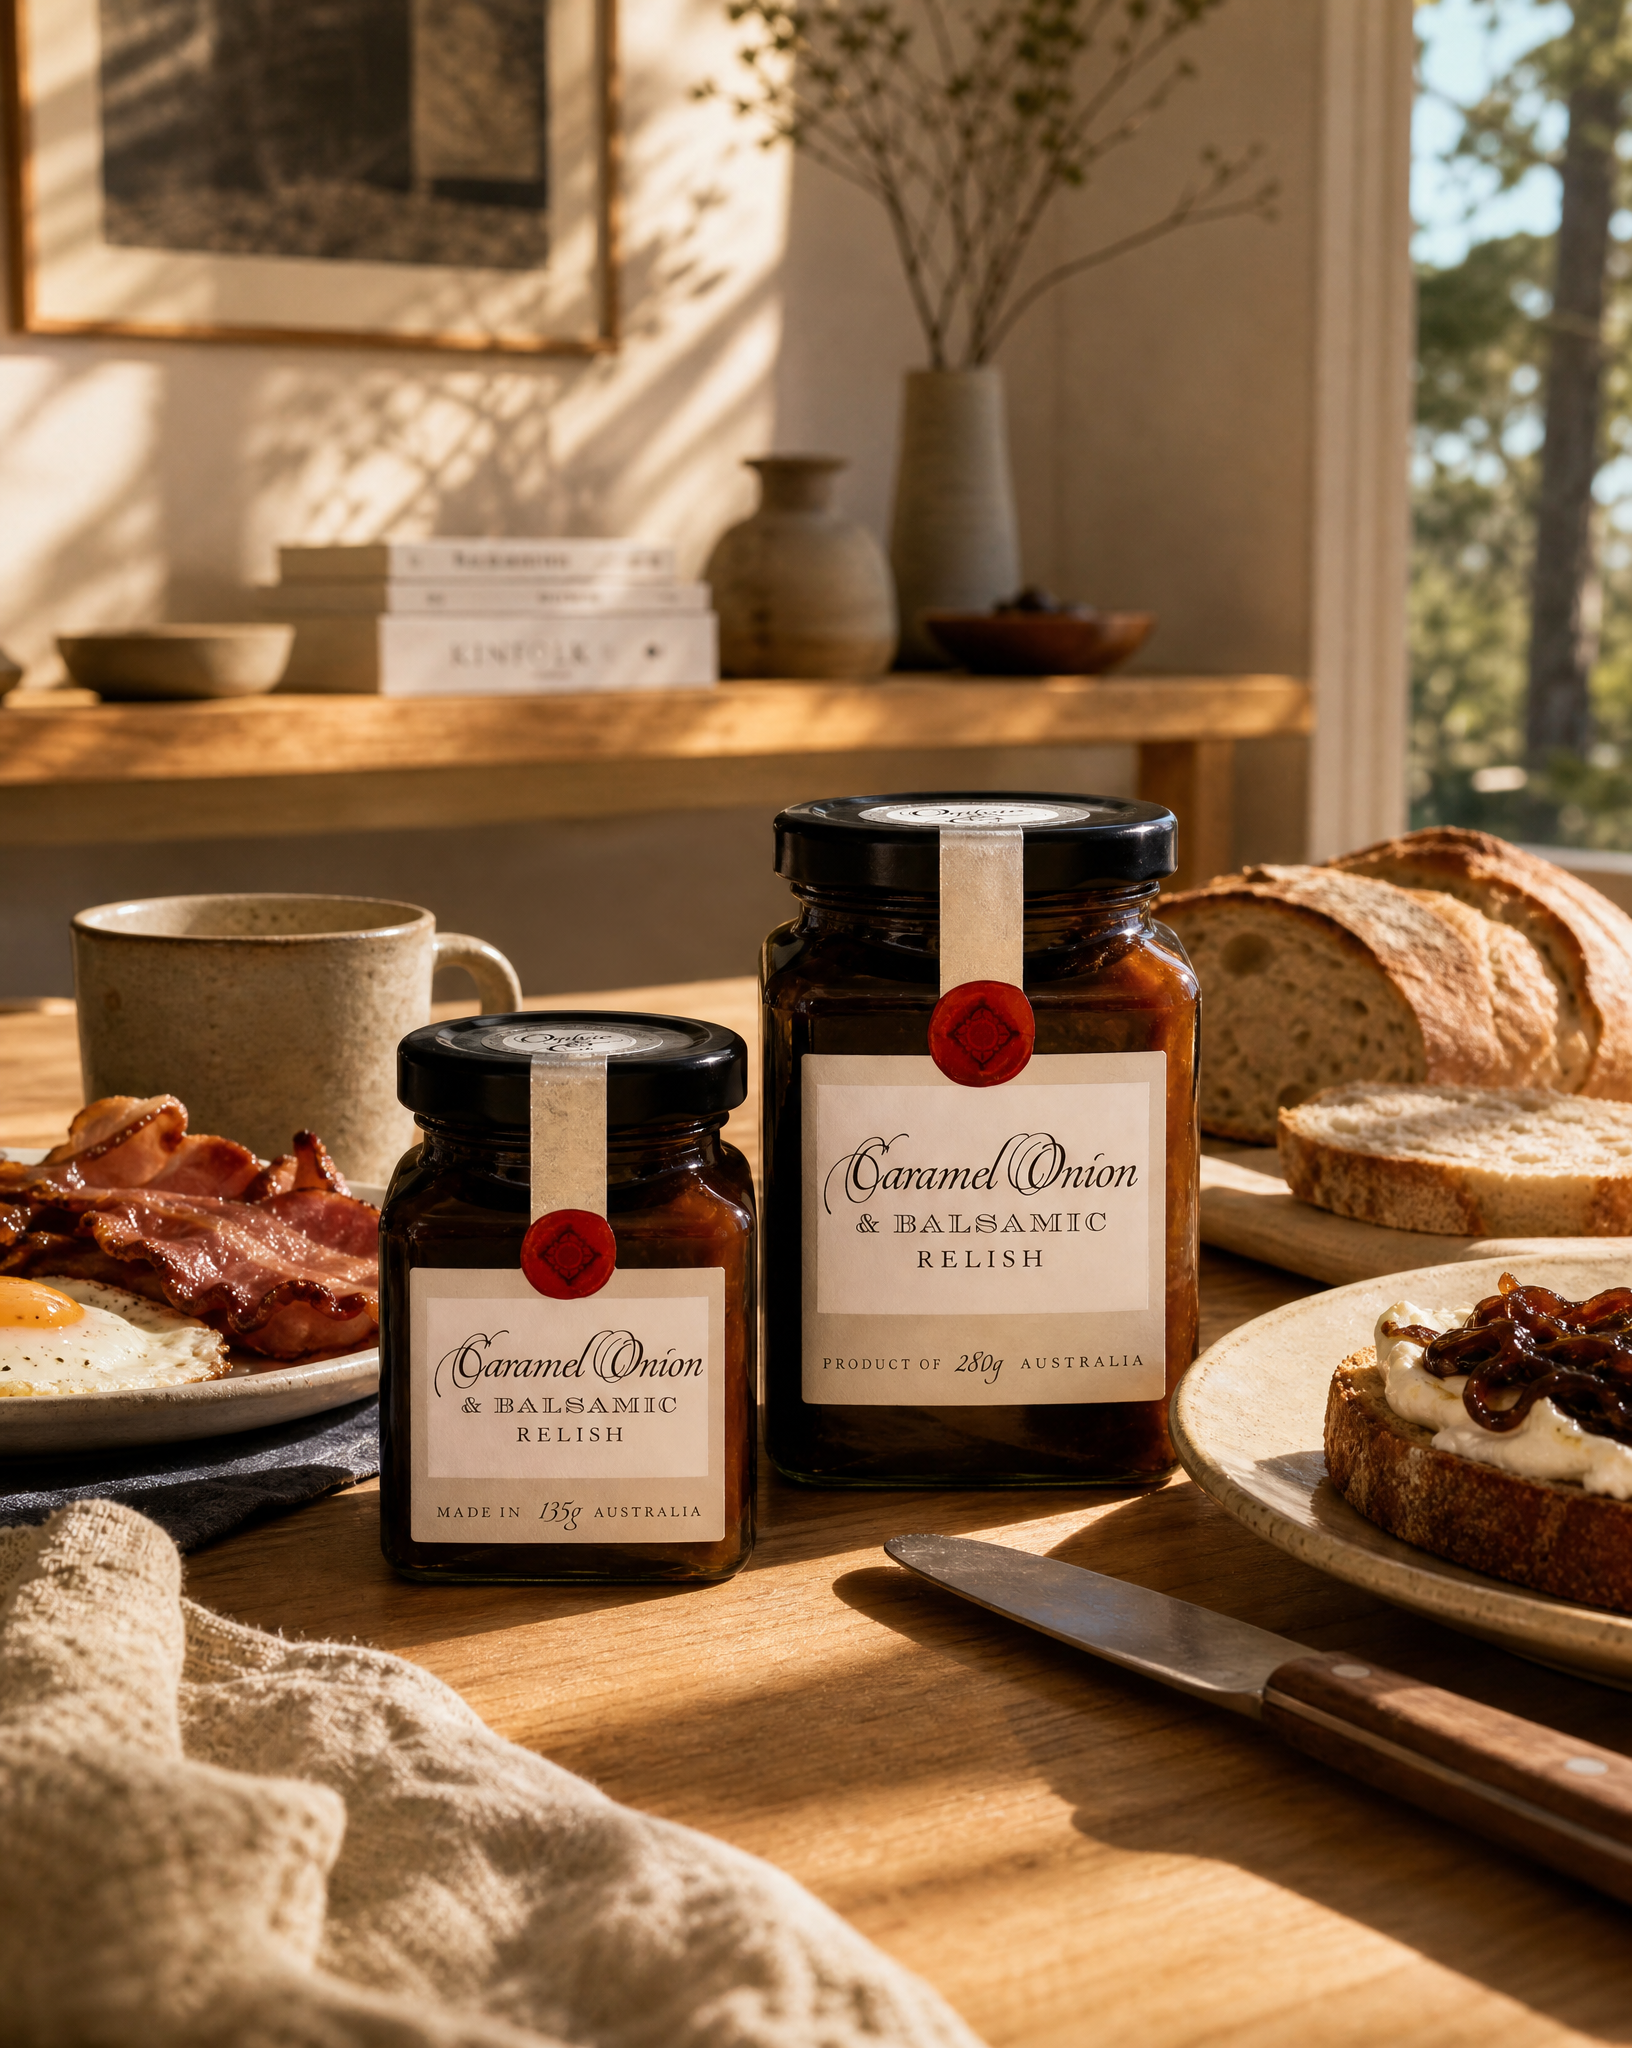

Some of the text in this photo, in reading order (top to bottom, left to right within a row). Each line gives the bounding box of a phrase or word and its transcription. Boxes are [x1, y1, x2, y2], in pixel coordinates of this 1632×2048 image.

[824, 1132, 1139, 1215] Caramel Onion
[855, 1212, 1107, 1234] & BALSAMIC
[917, 1249, 1043, 1269] RELISH
[434, 1330, 703, 1397] Caramel Onion
[823, 1351, 1144, 1385] PRODUCT OF 280g AUSTRALIA
[461, 1396, 677, 1414] & BALSAMIC
[516, 1426, 623, 1442] RELISH
[436, 1500, 701, 1531] MADE IN 135g AUSTRALIA
